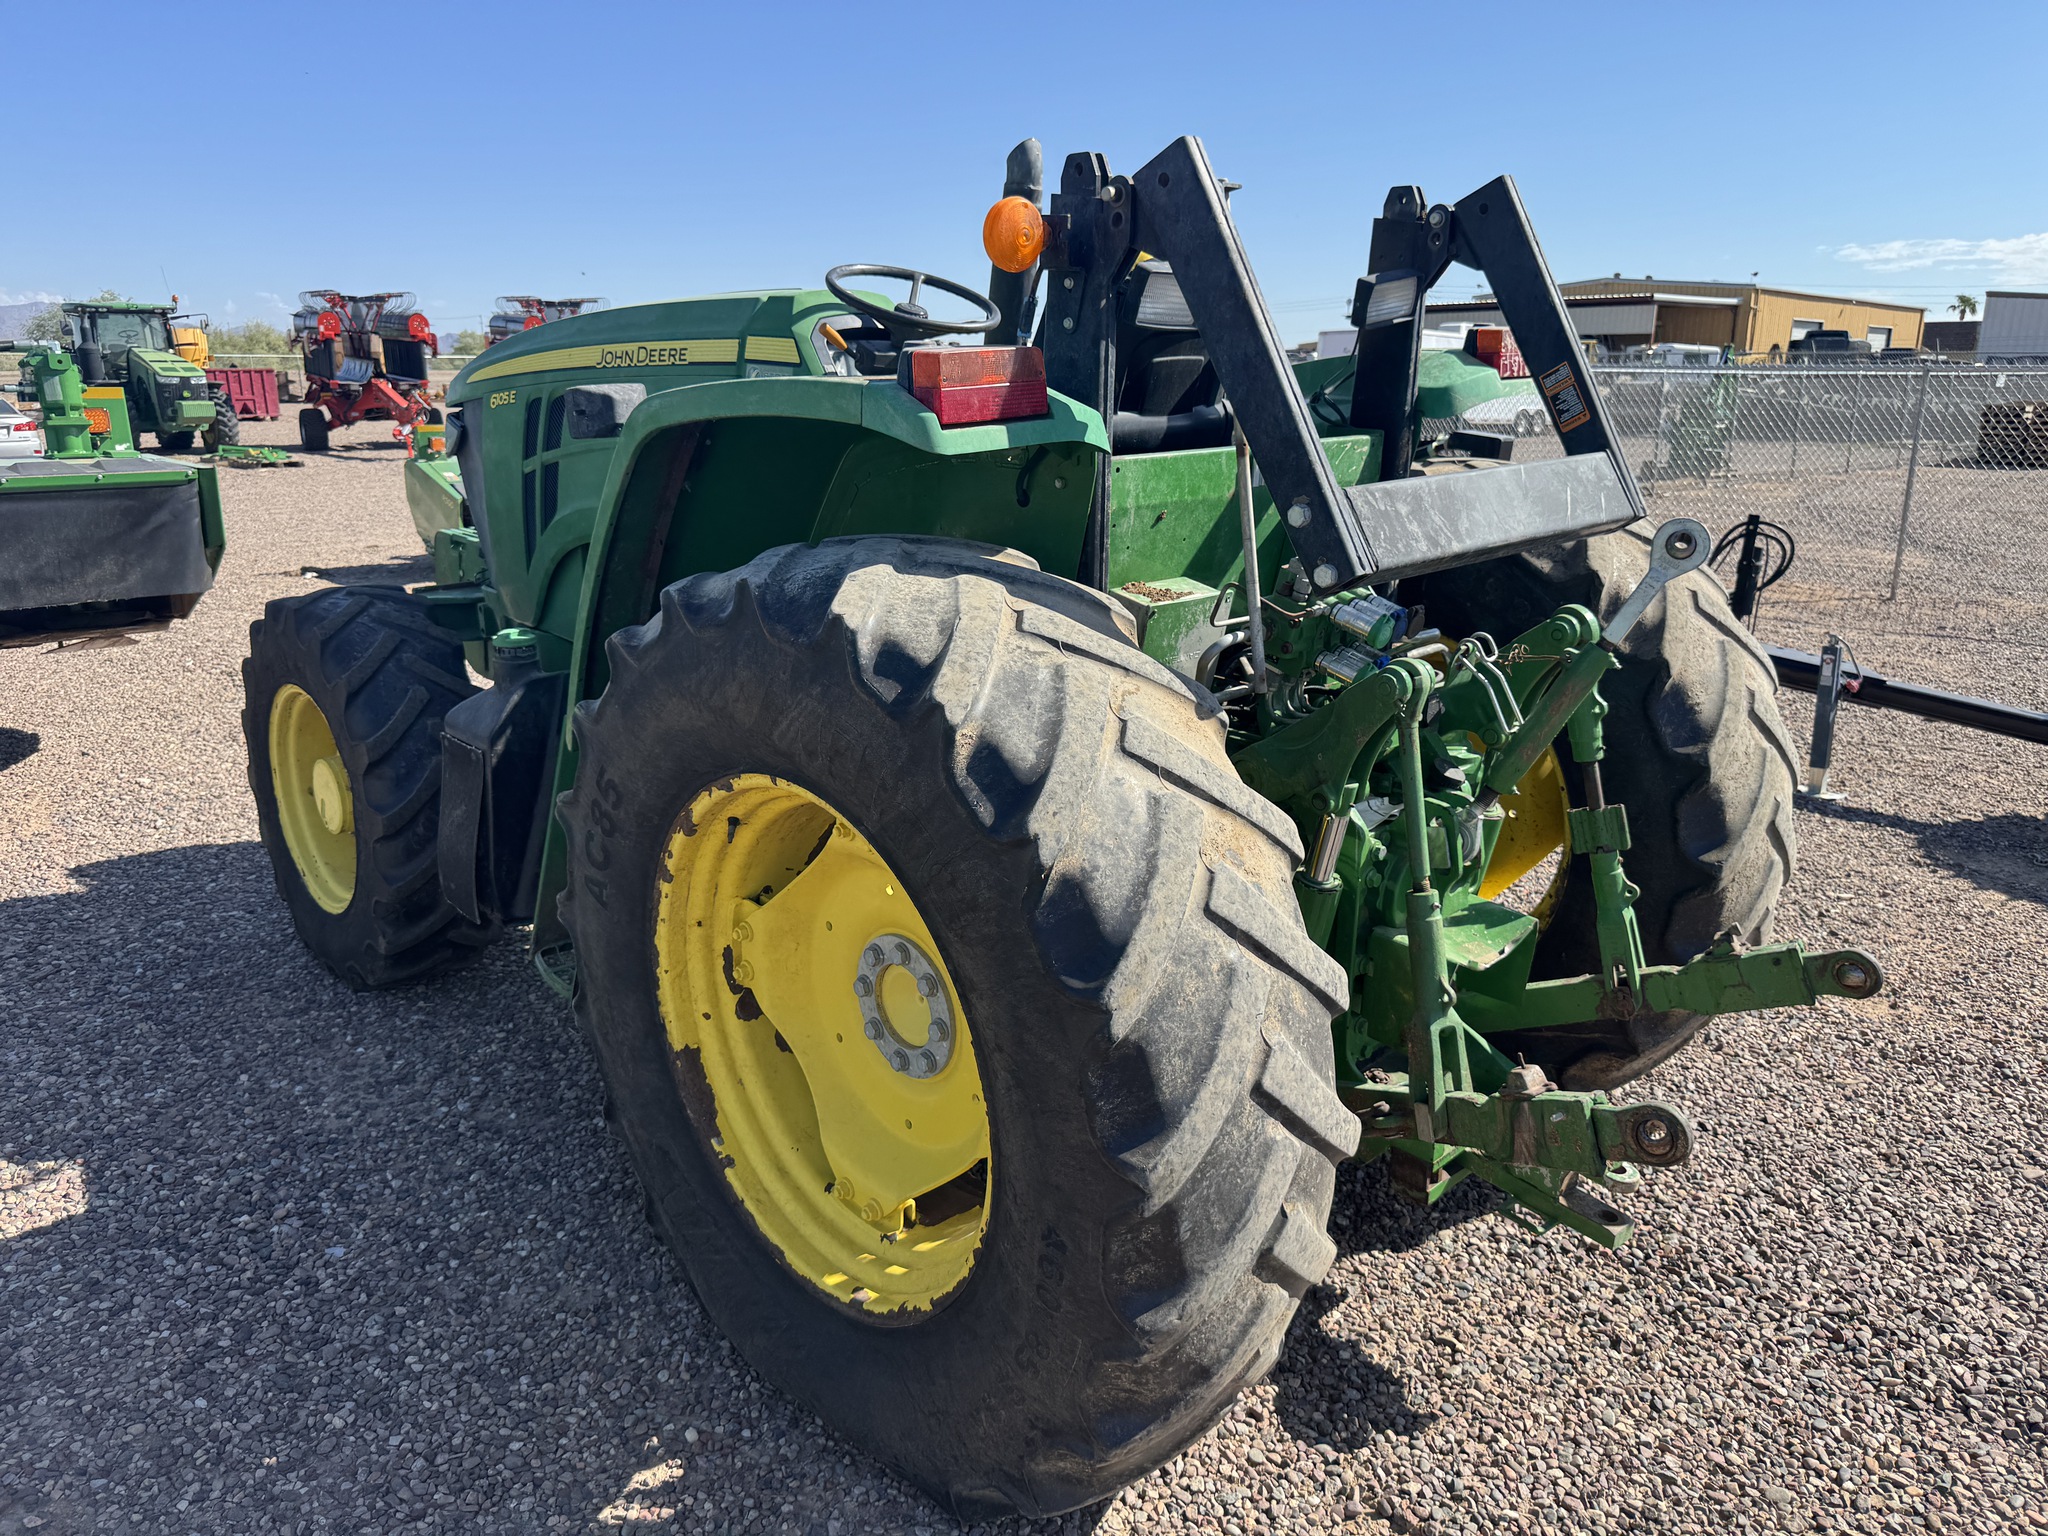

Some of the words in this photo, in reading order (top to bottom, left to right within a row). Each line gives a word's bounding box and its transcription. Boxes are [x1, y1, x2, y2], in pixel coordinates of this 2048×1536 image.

[596, 348, 635, 367] JOHN
[636, 346, 689, 364] DEERE
[584, 764, 623, 912] AC85
